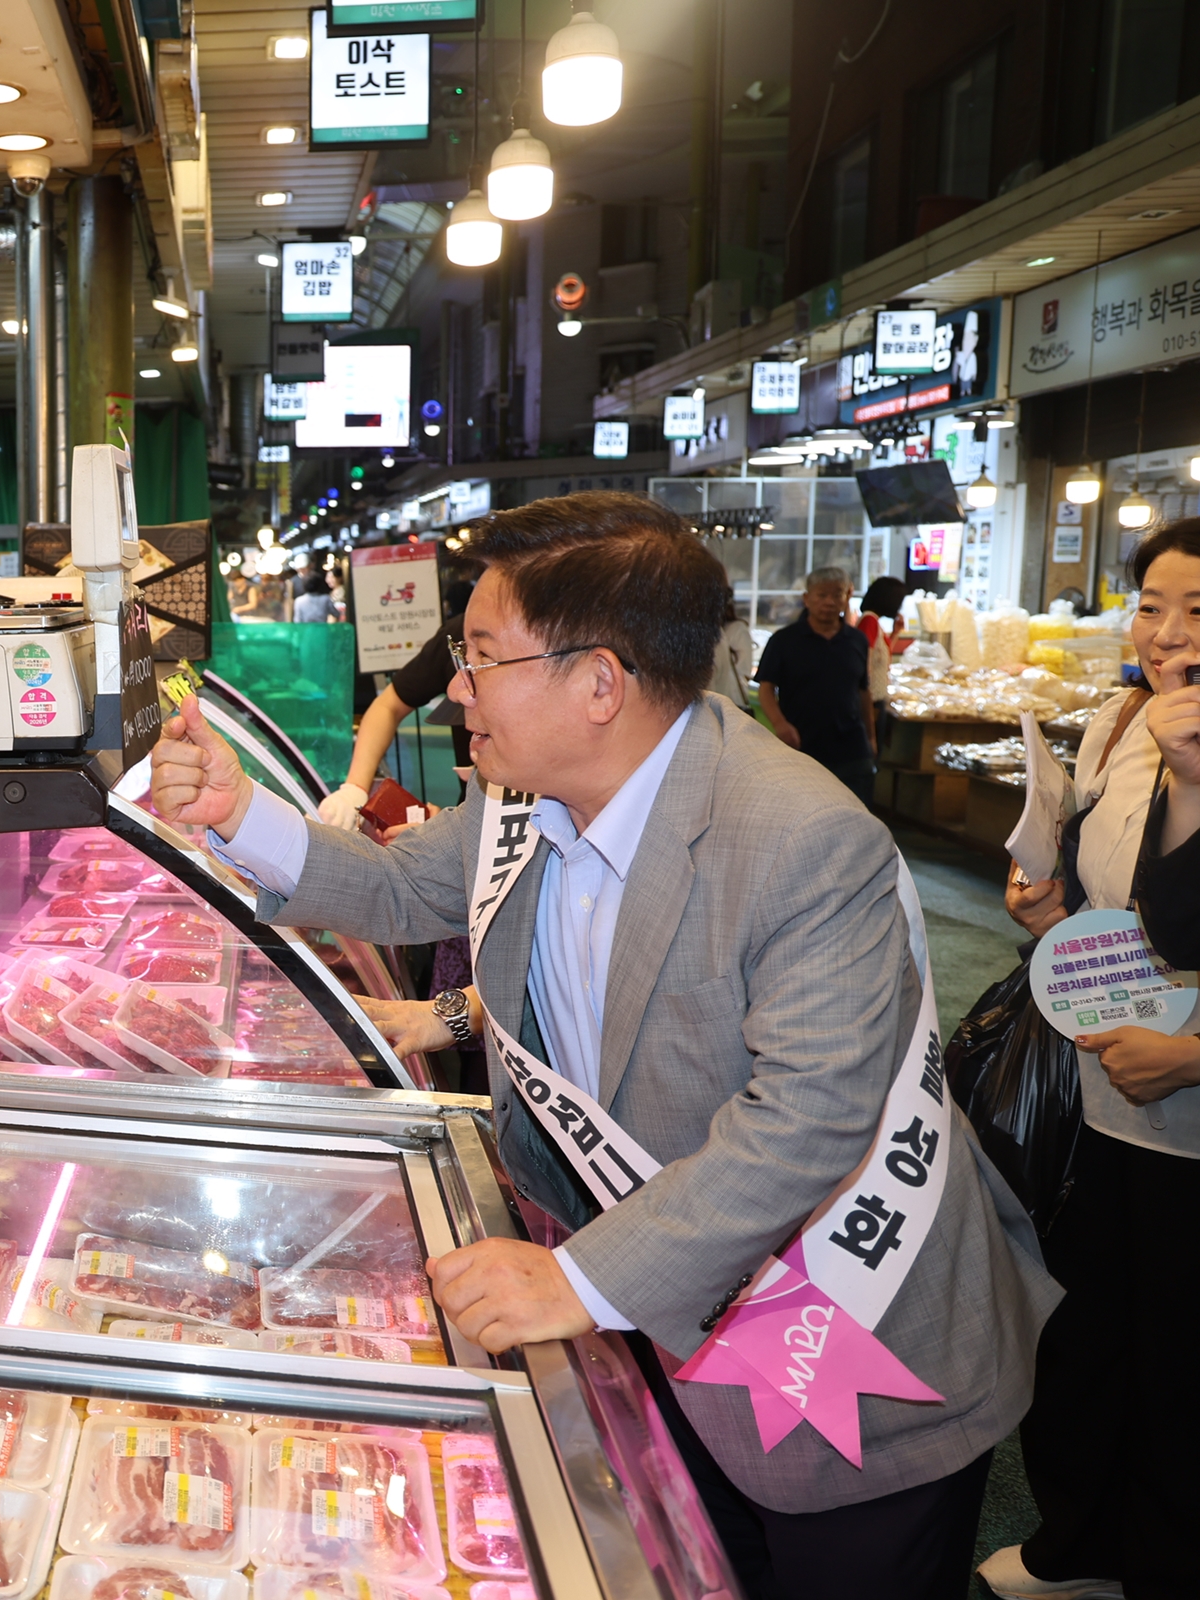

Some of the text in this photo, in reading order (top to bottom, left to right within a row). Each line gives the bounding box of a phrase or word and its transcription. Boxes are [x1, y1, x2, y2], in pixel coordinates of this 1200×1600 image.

[348, 39, 395, 65] 이삭
[335, 71, 406, 98] 토스트
[335, 247, 349, 258] 32
[295, 260, 340, 276] 엄마손
[303, 281, 331, 296] 김밥
[1092, 297, 1143, 343] 행복과
[1053, 927, 1145, 956] 서울망원치과
[780, 1304, 835, 1408] MAPO
